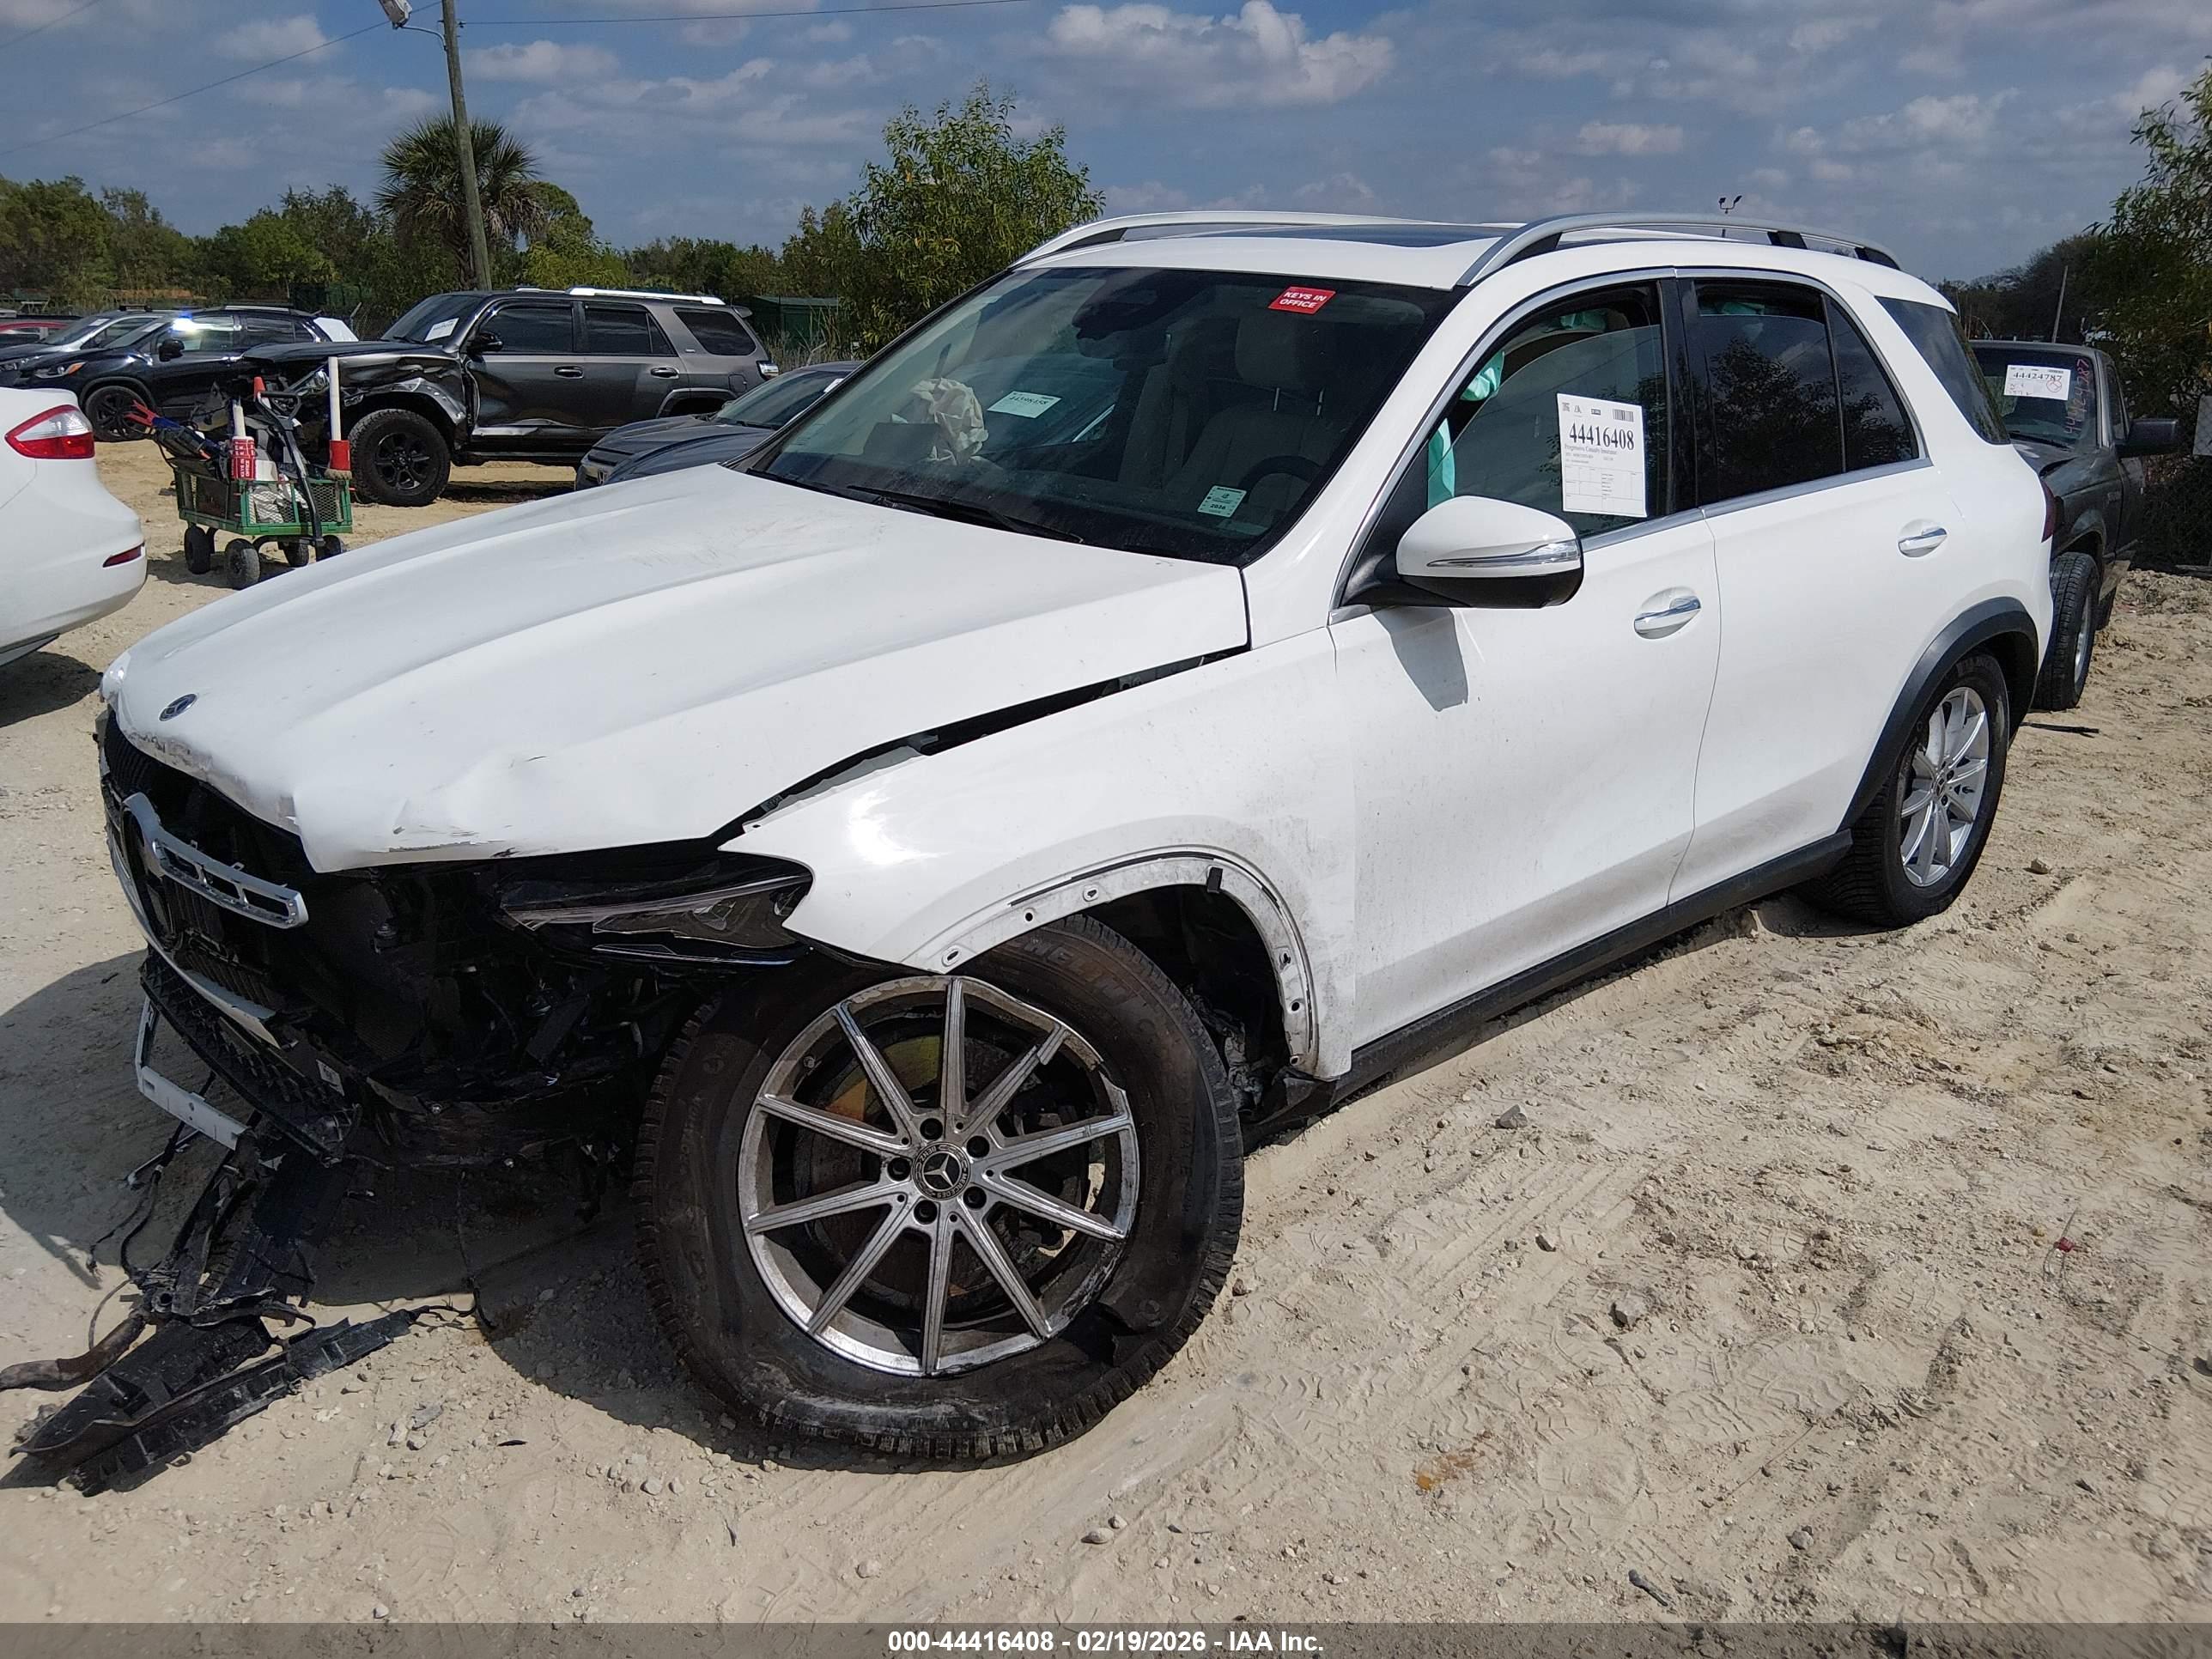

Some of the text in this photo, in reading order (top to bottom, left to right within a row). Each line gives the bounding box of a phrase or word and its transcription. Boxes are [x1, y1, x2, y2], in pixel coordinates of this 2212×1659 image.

[1279, 299, 1317, 308] OFFICE
[2013, 372, 2063, 381] 44424787
[1570, 422, 1634, 450] 44416408
[1007, 939, 1134, 1003] CHELIN
[937, 1173, 967, 1199] MERCEDES
